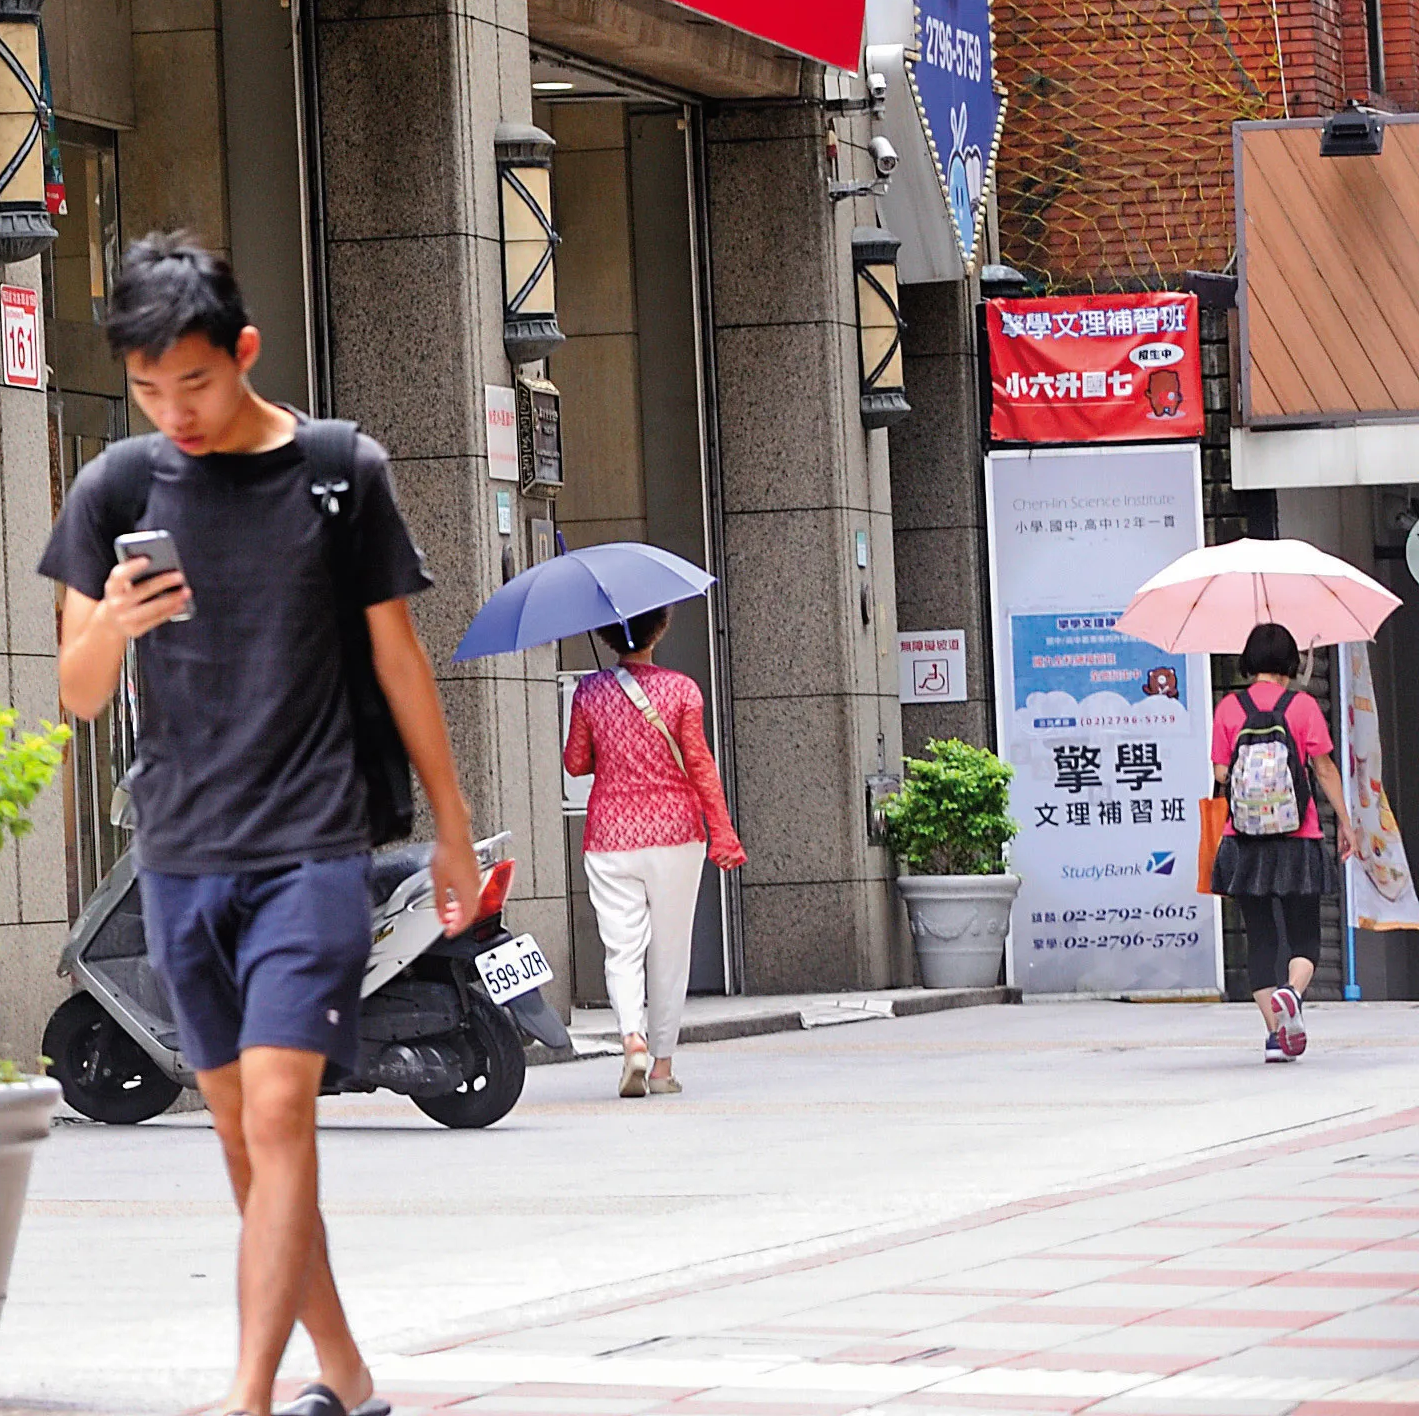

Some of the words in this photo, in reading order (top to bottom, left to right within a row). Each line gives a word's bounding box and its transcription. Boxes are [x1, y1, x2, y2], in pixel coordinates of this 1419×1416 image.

[925, 15, 982, 83] 2796-5759
[1001, 304, 1187, 341] 擎學文理補習班
[9, 325, 34, 371] 161
[1006, 371, 1133, 399] 小六升國七
[1071, 495, 1120, 509] Science
[1124, 493, 1175, 507] Institute
[1053, 742, 1163, 794] 擎學
[1035, 798, 1186, 827] 文理補習班
[1061, 863, 1142, 881] StudyBank
[1062, 903, 1198, 925] 02-2792-6615
[1064, 931, 1199, 953] 02-2796-5759
[485, 950, 549, 995] 599-JZR
